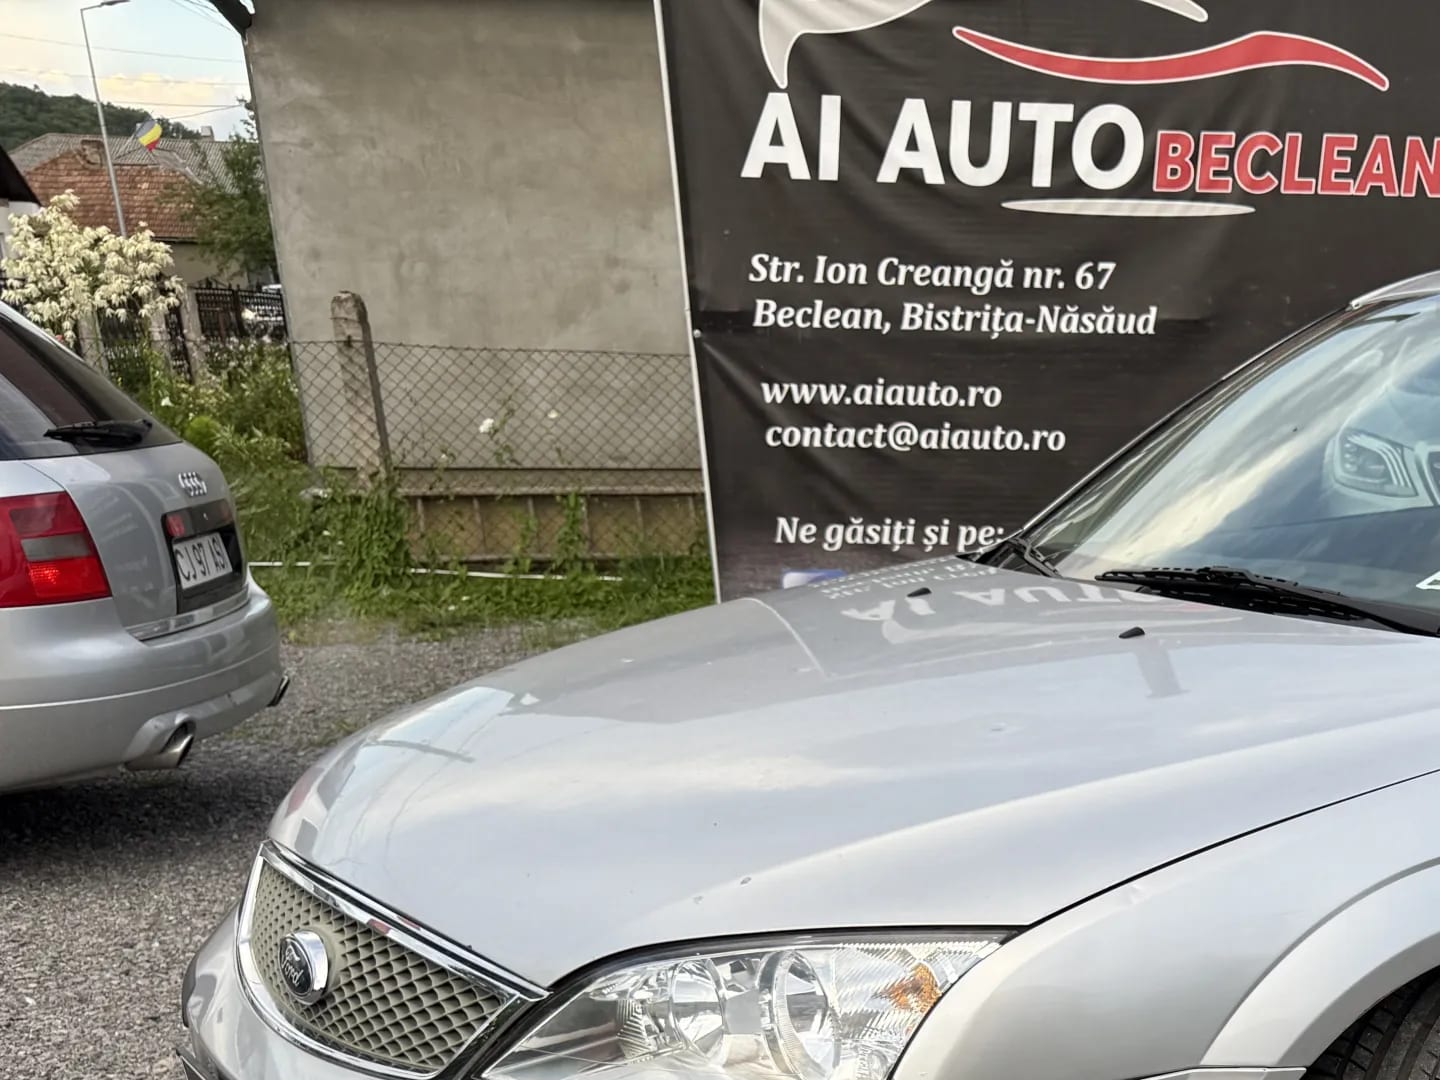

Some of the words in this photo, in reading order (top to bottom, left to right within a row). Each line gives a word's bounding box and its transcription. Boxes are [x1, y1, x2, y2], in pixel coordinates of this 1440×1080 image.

[741, 92, 842, 181] AI
[876, 97, 1145, 190] AUTO
[748, 253, 804, 284] Str.
[813, 255, 868, 285] Ion
[876, 257, 1014, 296] Creangă
[1022, 265, 1065, 289] nr.
[1074, 261, 1117, 290] 67
[752, 298, 892, 335] Beclean,
[900, 302, 1158, 340] Bistrița-Năsăud
[760, 377, 1003, 408] www.aiauto.ro
[765, 421, 1067, 452] contact@aiauto.ro
[774, 516, 817, 544] Ne
[822, 517, 916, 553] găsiți
[923, 519, 950, 553] și
[281, 943, 305, 987] Ford
